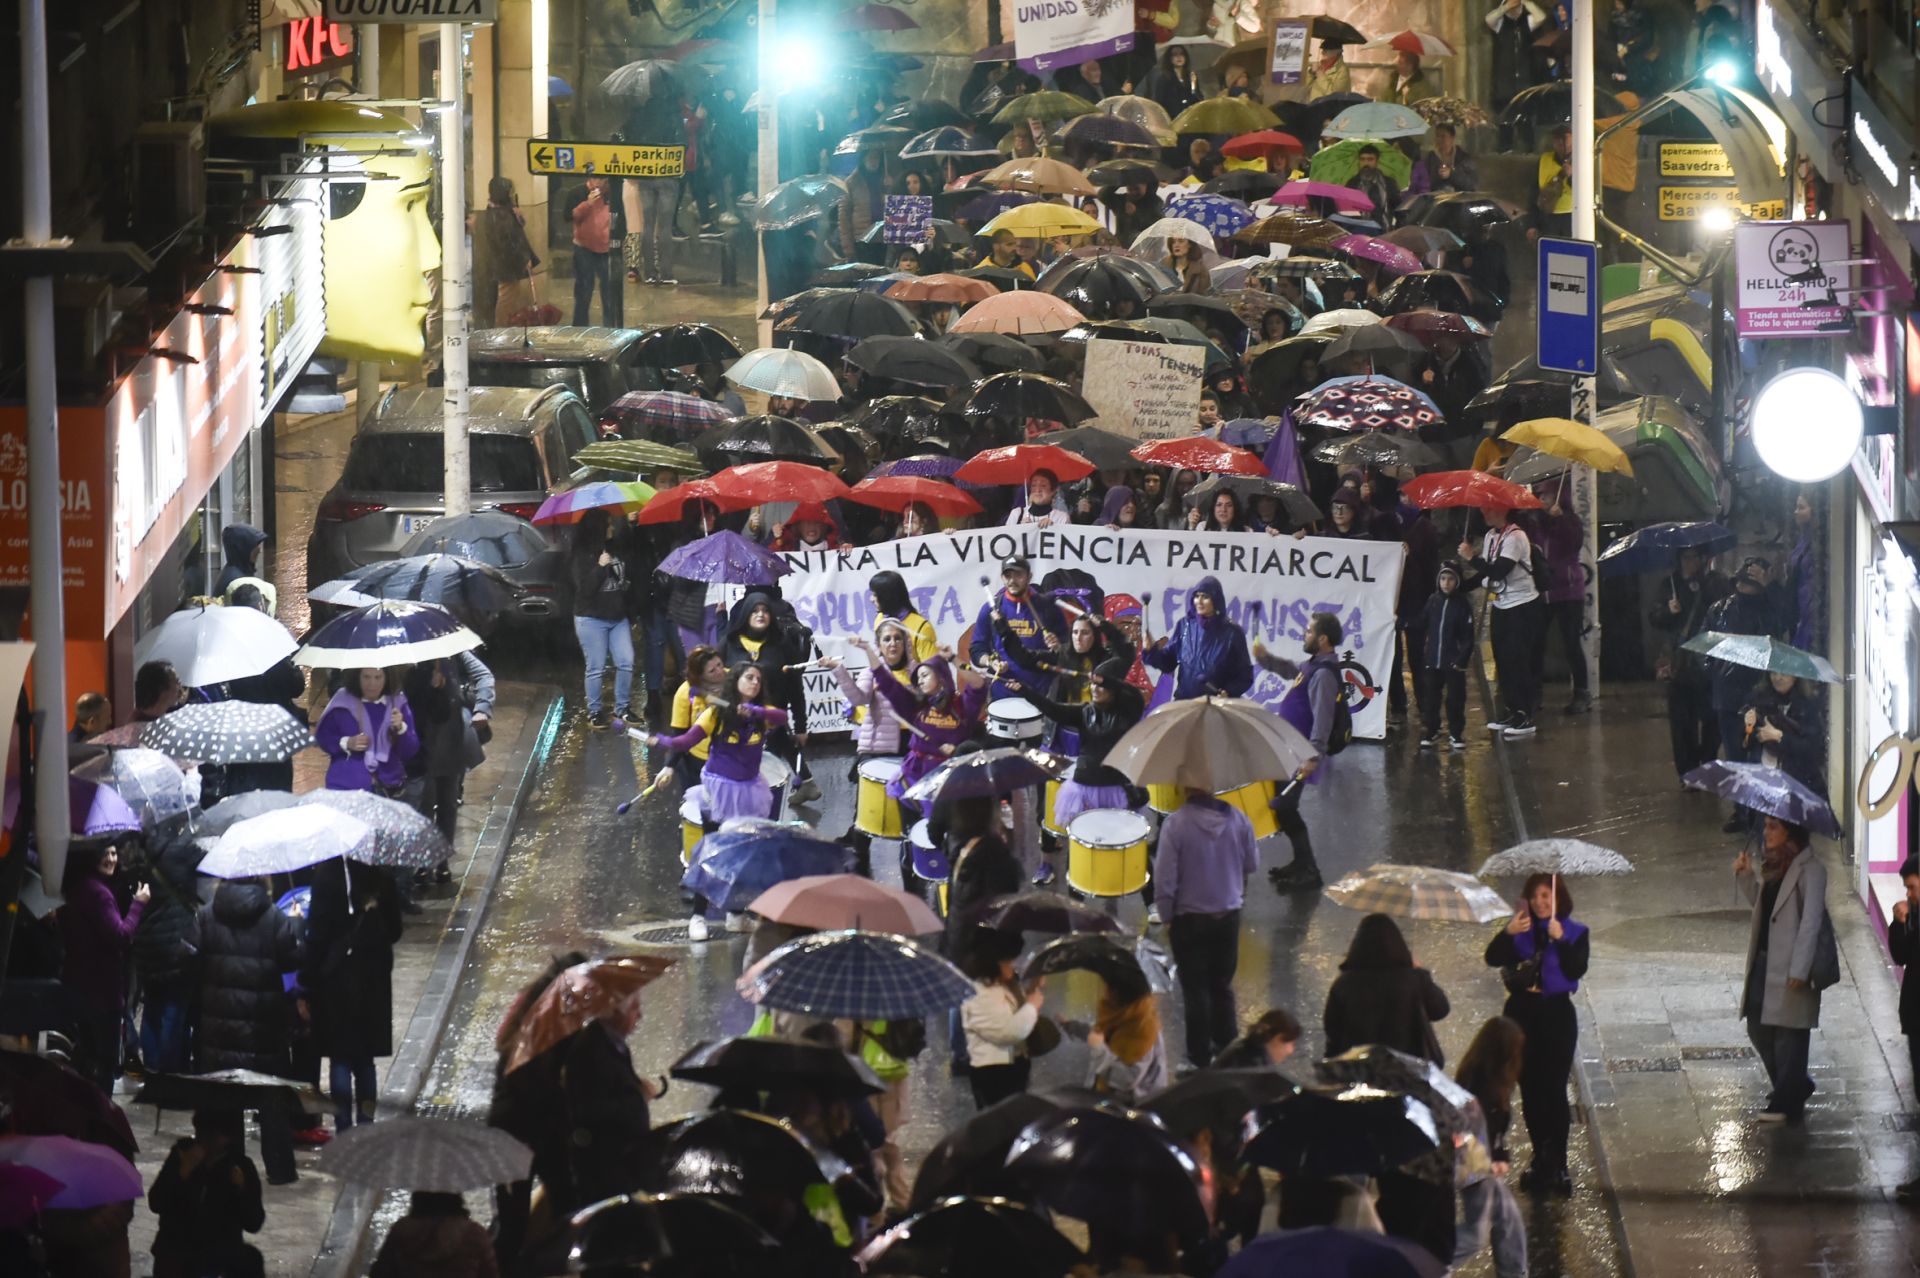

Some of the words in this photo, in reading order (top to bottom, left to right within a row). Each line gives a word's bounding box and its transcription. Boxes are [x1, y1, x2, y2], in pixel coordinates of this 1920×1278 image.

[1018, 0, 1078, 23] UNIDAD
[287, 15, 349, 70] KFC
[633, 149, 682, 161] parking
[604, 162, 681, 174] universidad
[1662, 190, 1719, 200] Mercado
[1747, 278, 1793, 289] HELLO
[1798, 277, 1838, 289] SHOP
[1778, 288, 1806, 301] 24h
[1783, 319, 1799, 328] que
[1123, 343, 1160, 357] TODAS
[1160, 356, 1204, 378] TENEMOS
[895, 541, 938, 568] LA
[950, 531, 1151, 566] VIOLENCIA
[1167, 540, 1376, 582] PATRIARCAL
